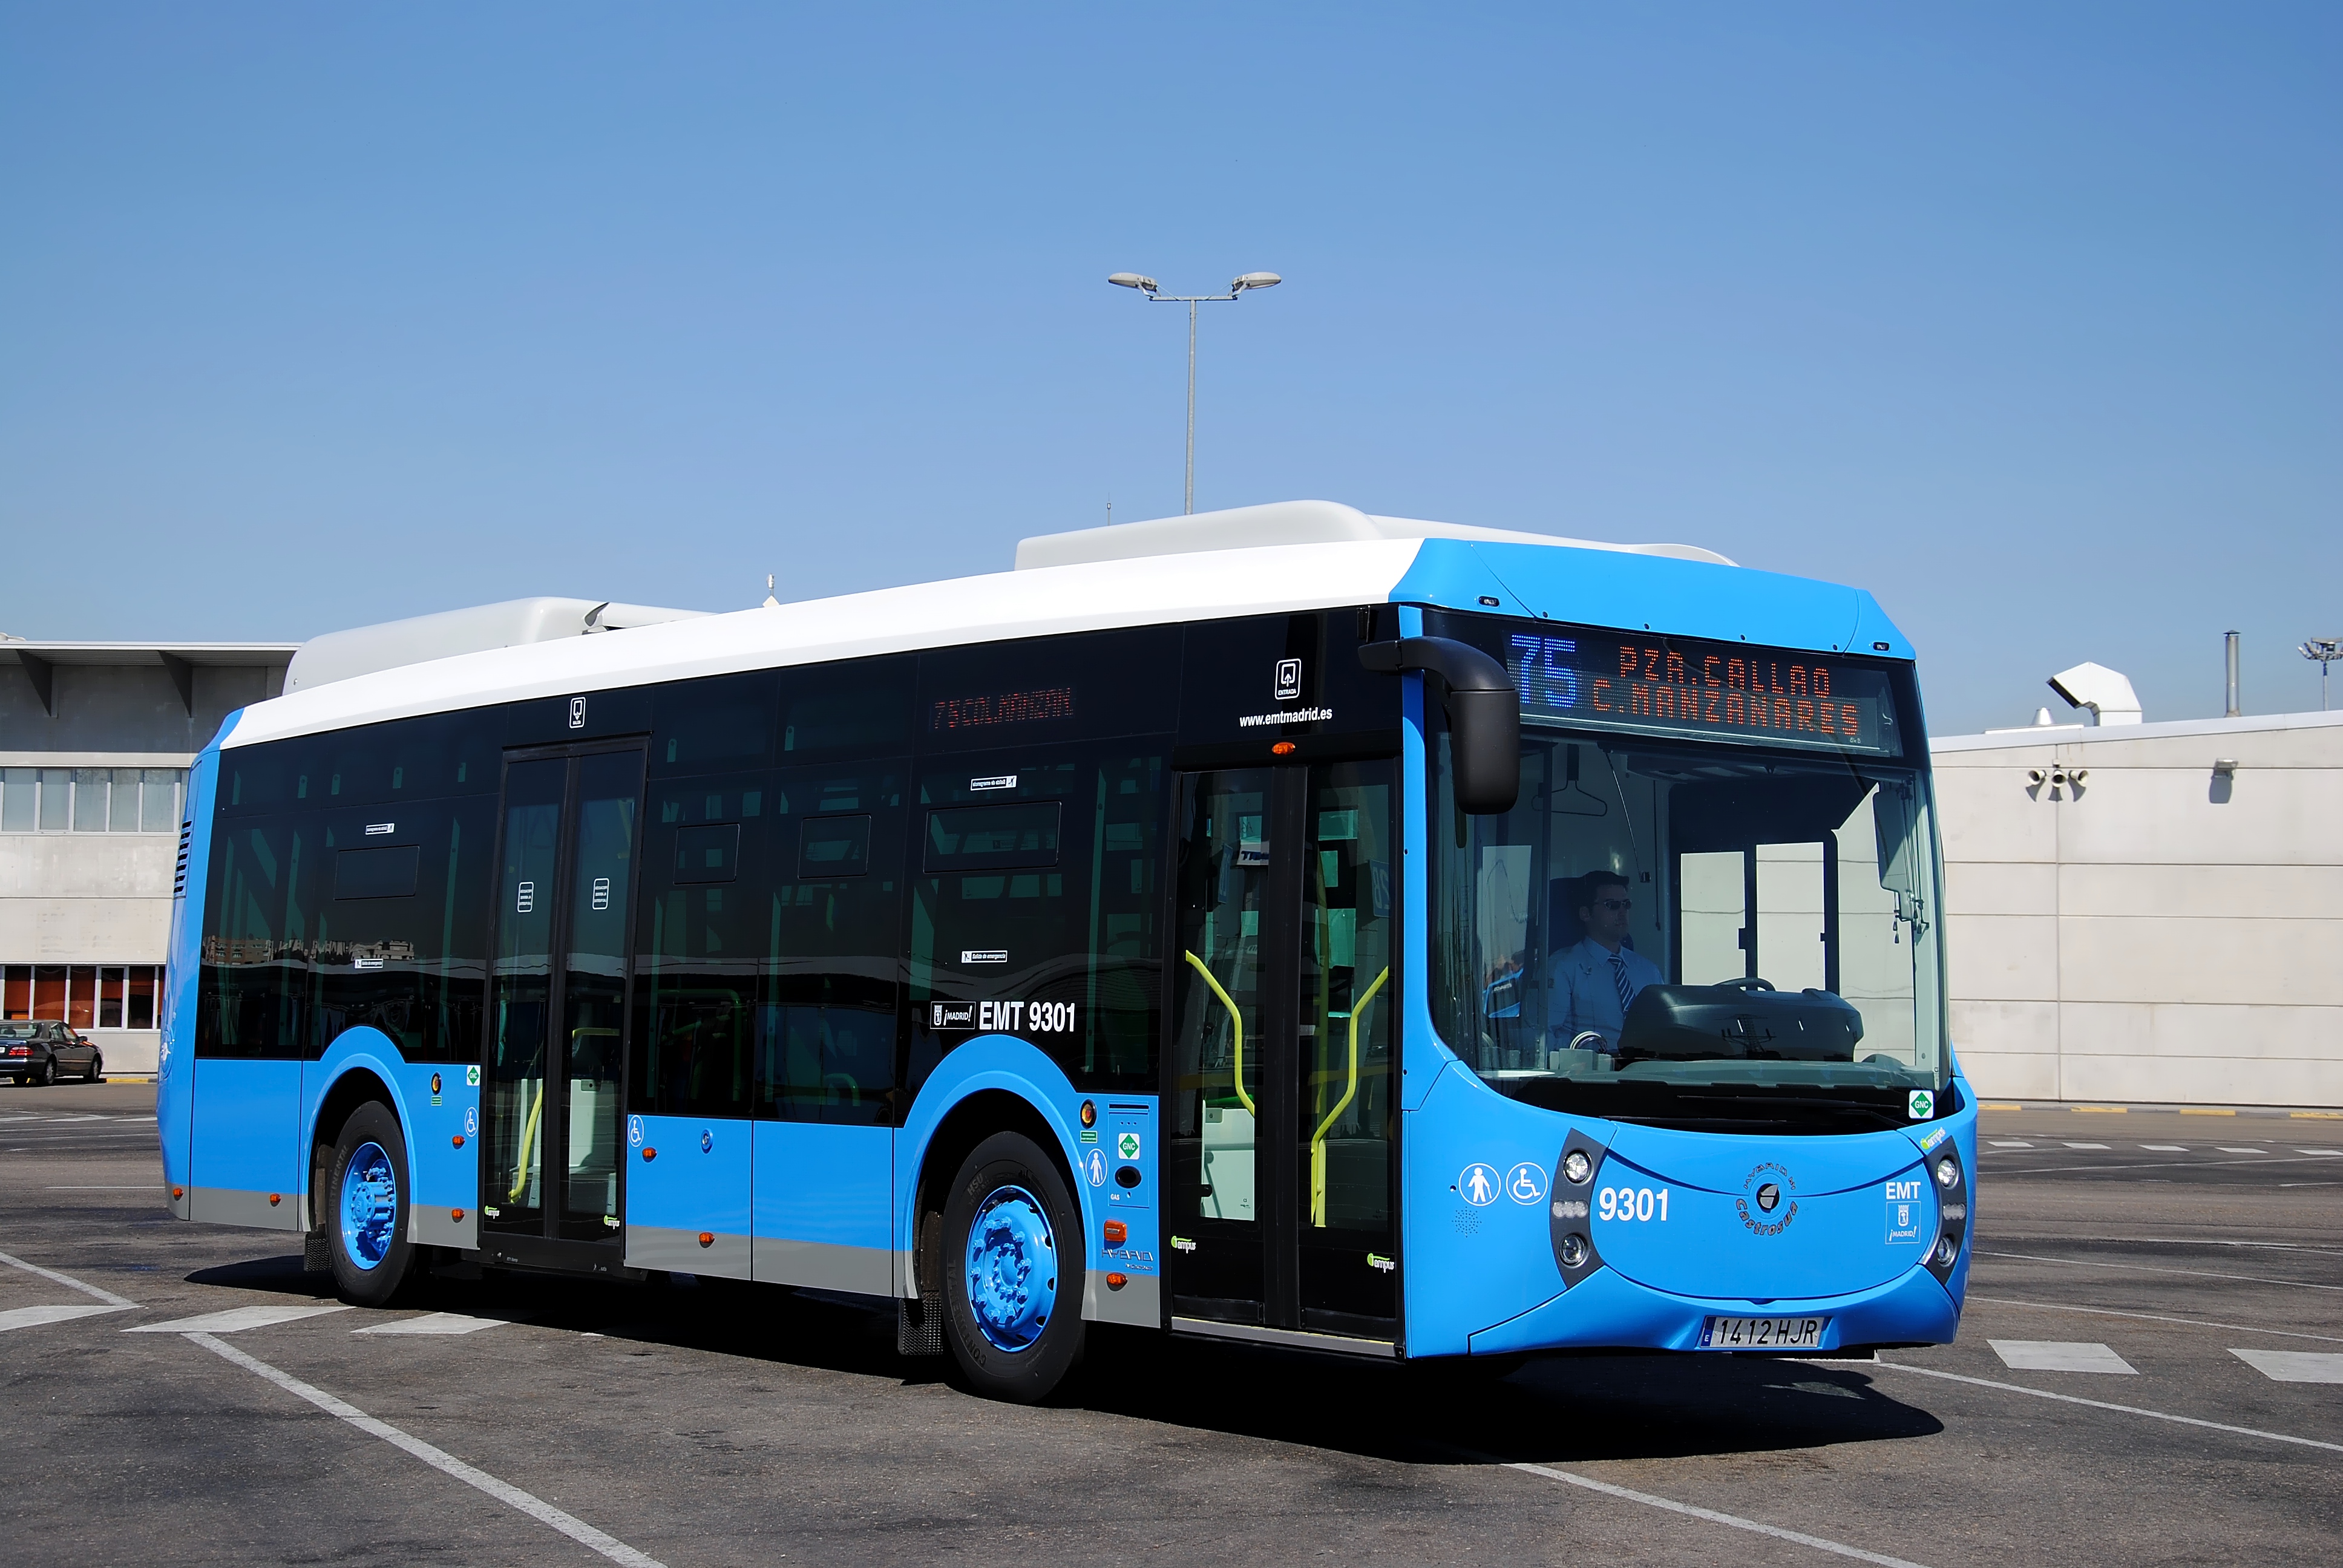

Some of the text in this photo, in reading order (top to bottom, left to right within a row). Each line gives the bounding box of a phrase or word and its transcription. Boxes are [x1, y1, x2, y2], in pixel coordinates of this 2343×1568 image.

[1512, 634, 1576, 709] 75
[1239, 707, 1332, 727] www.emtmadrid.es
[979, 1001, 1075, 1032] EMT 9301
[1914, 1100, 1929, 1109] GNC
[1122, 1142, 1136, 1151] GNC
[1886, 1181, 1921, 1200] EMT
[1599, 1187, 1669, 1222] 9301
[1101, 1247, 1155, 1263] HYBRID
[1720, 1319, 1818, 1345] 1412 HJR
